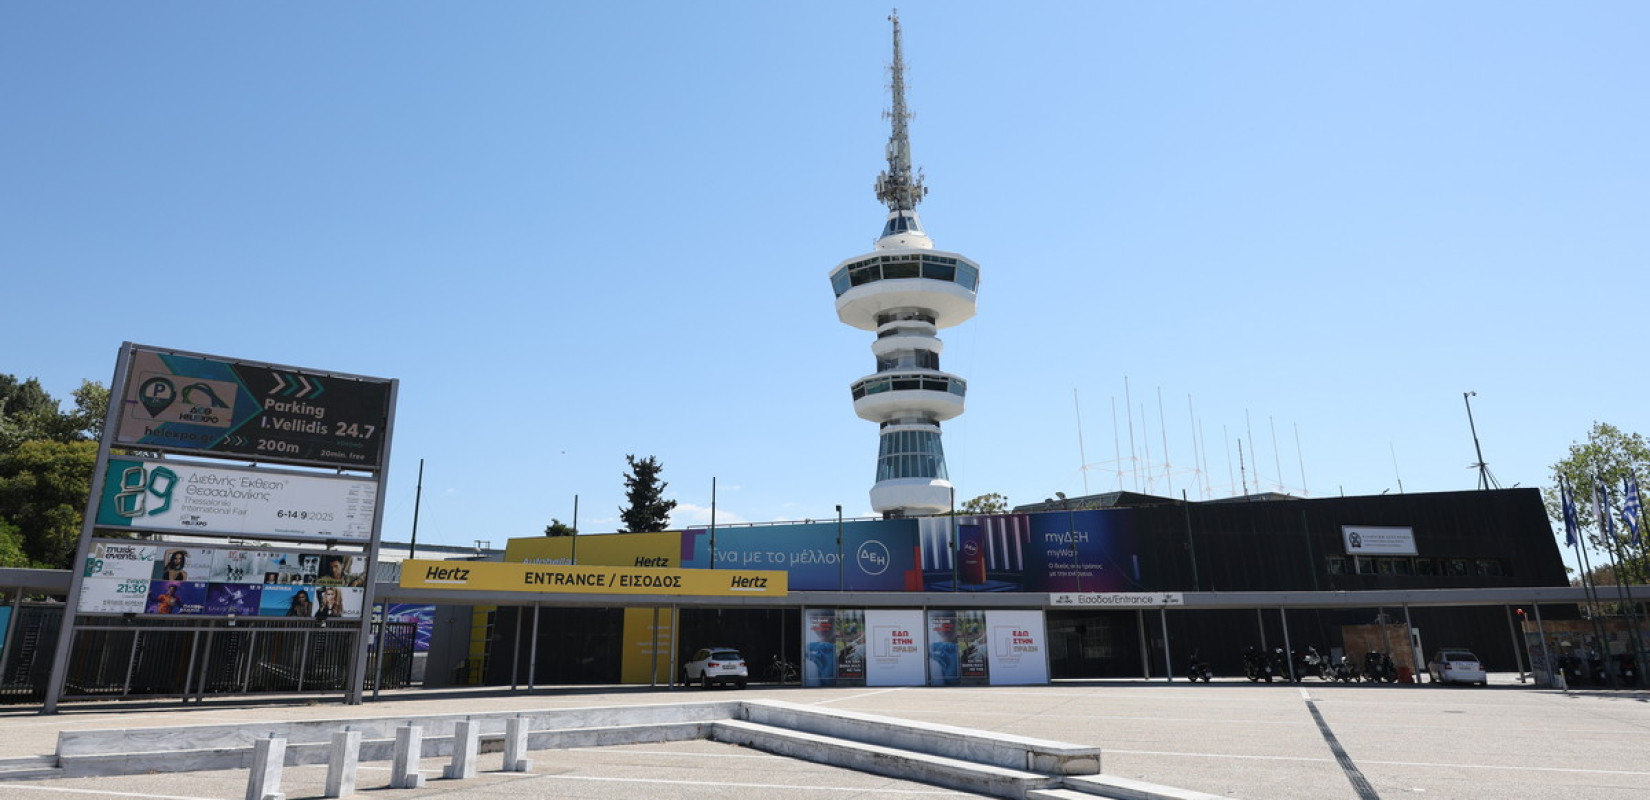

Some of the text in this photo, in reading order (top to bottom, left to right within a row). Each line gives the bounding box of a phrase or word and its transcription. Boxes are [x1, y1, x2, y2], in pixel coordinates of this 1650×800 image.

[264, 398, 325, 419] Parking
[335, 421, 375, 439] 24.7
[257, 439, 299, 453] 200m
[349, 450, 365, 460] free
[188, 473, 236, 487] Διεθνής
[186, 484, 271, 502] Θεσσαλονίκης
[184, 496, 232, 507] Thessaloniki
[180, 503, 248, 516] International Fair
[106, 546, 136, 554] music
[634, 556, 669, 568] Hertz
[744, 551, 761, 565] με
[765, 551, 786, 563] το
[790, 549, 845, 567] μέλλον
[860, 550, 885, 566] ΔΕΗ
[425, 565, 470, 581] Hertz
[524, 571, 606, 587] ENTRANCE
[619, 575, 682, 589] ΕΙΣΟΔΟΣ
[116, 583, 147, 594] 21:30
[731, 575, 768, 588] Hertz
